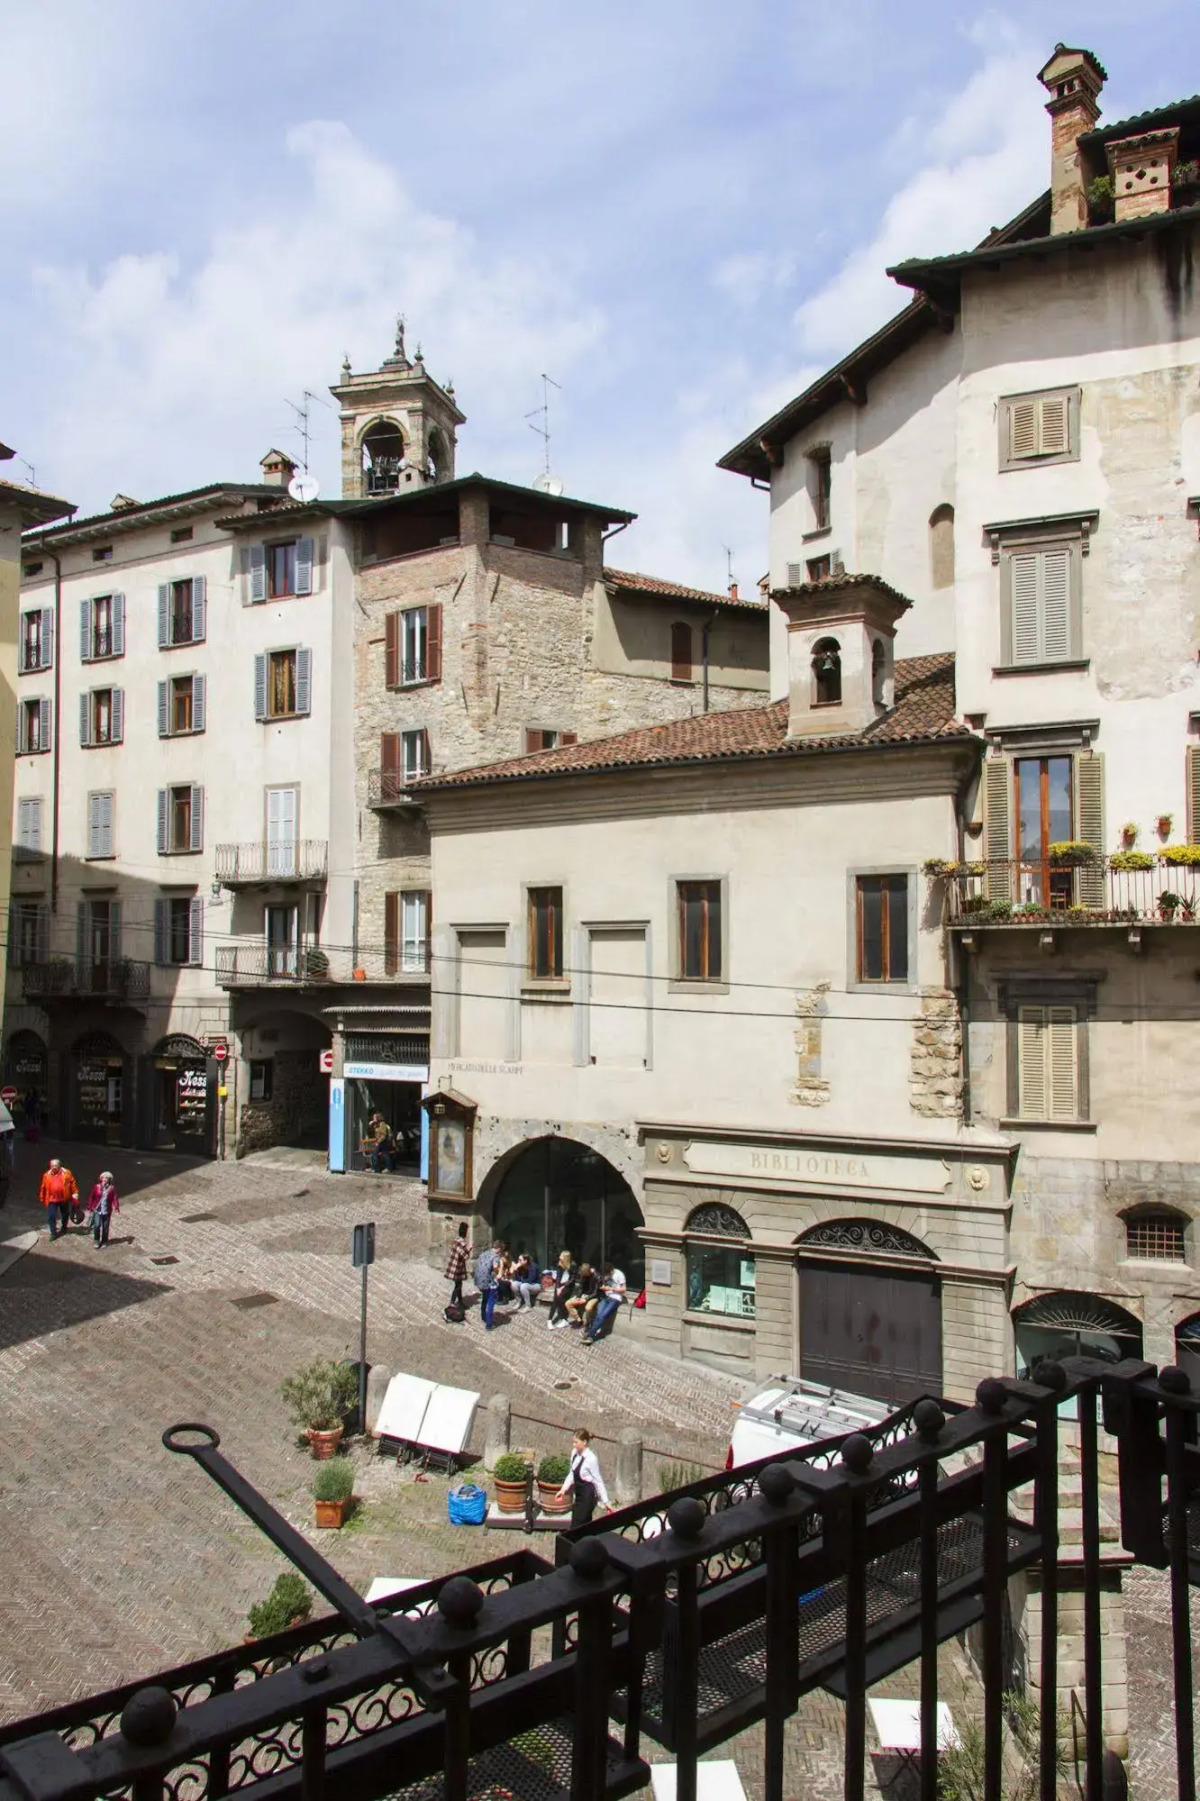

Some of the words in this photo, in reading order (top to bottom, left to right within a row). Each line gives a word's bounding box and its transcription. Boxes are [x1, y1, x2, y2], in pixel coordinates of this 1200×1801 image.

[349, 1066, 374, 1075] STEKKO
[179, 1071, 207, 1087] Ness
[751, 1152, 870, 1177] BIBLIOTECA
